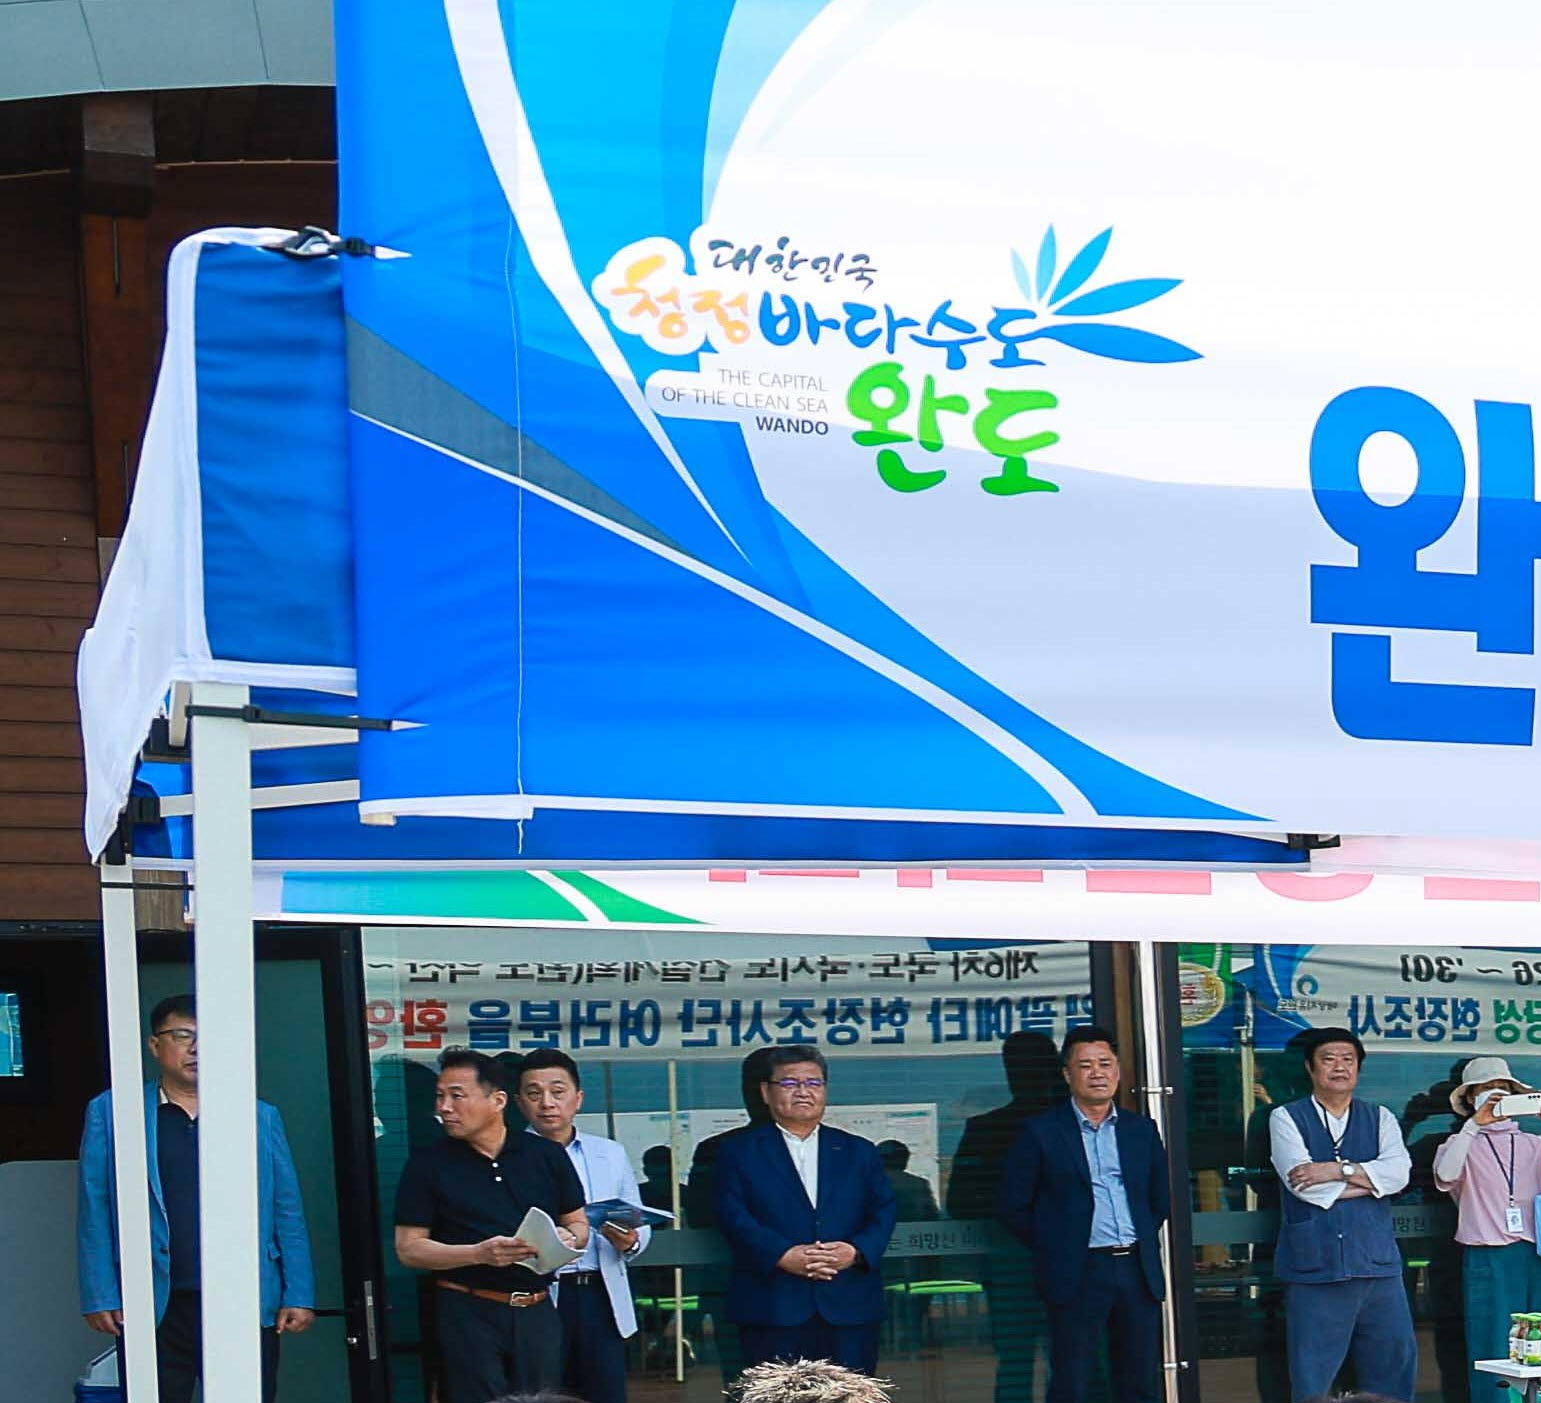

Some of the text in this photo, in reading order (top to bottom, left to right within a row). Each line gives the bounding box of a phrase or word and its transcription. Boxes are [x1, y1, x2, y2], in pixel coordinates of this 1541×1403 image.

[708, 236, 880, 292] 대한민국
[717, 368, 829, 393] THE CAPITAL
[661, 385, 829, 414] OF THE CLEAN SEA
[756, 415, 830, 436] WANDO
[844, 361, 1060, 496] 완도
